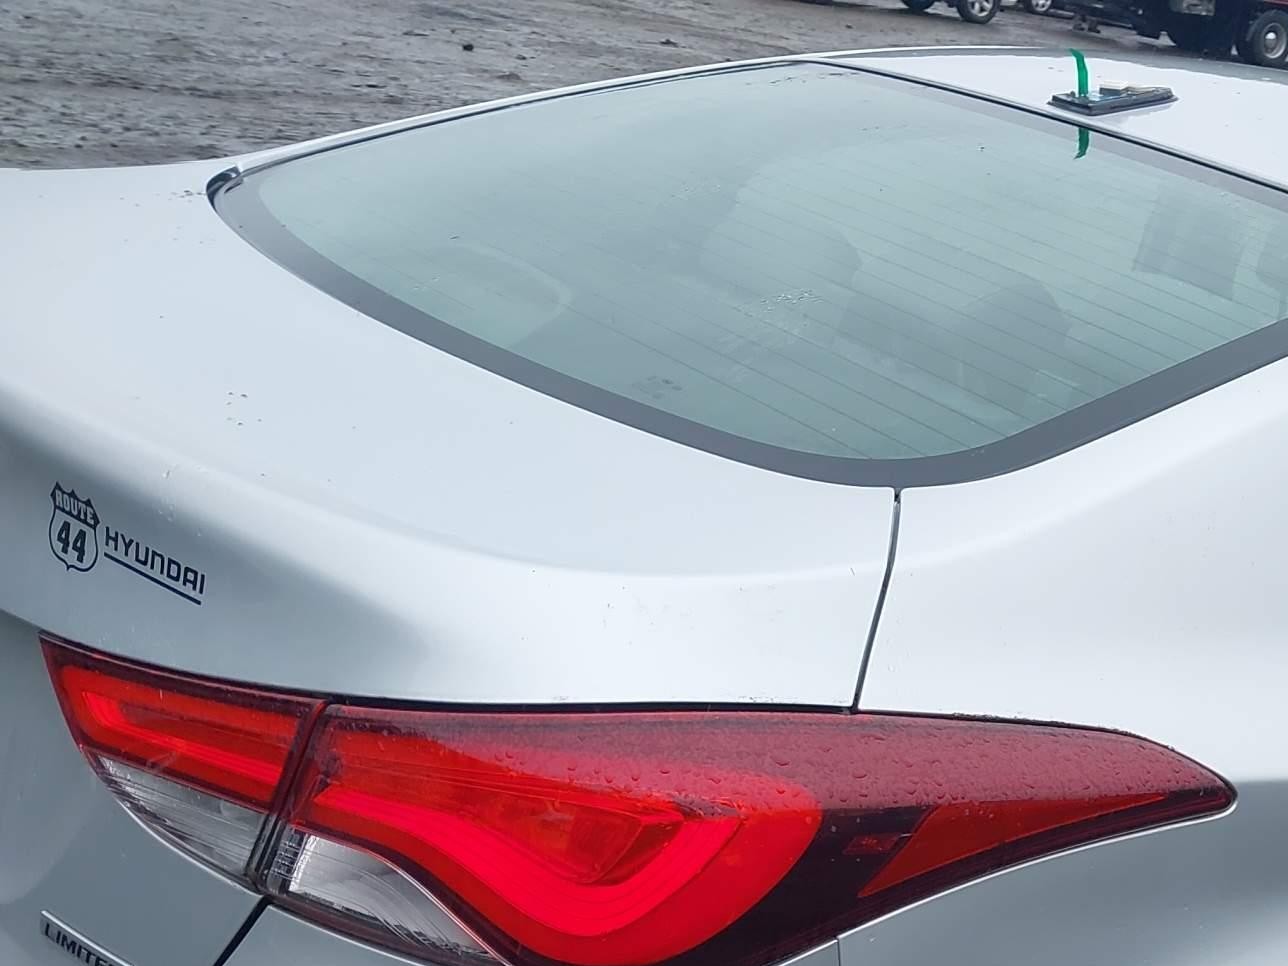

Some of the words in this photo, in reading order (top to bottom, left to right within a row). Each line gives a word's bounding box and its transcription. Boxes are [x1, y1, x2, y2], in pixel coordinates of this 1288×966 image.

[55, 488, 95, 525] ROUTE
[56, 520, 87, 564] 44
[105, 526, 206, 595] HYUNDAI
